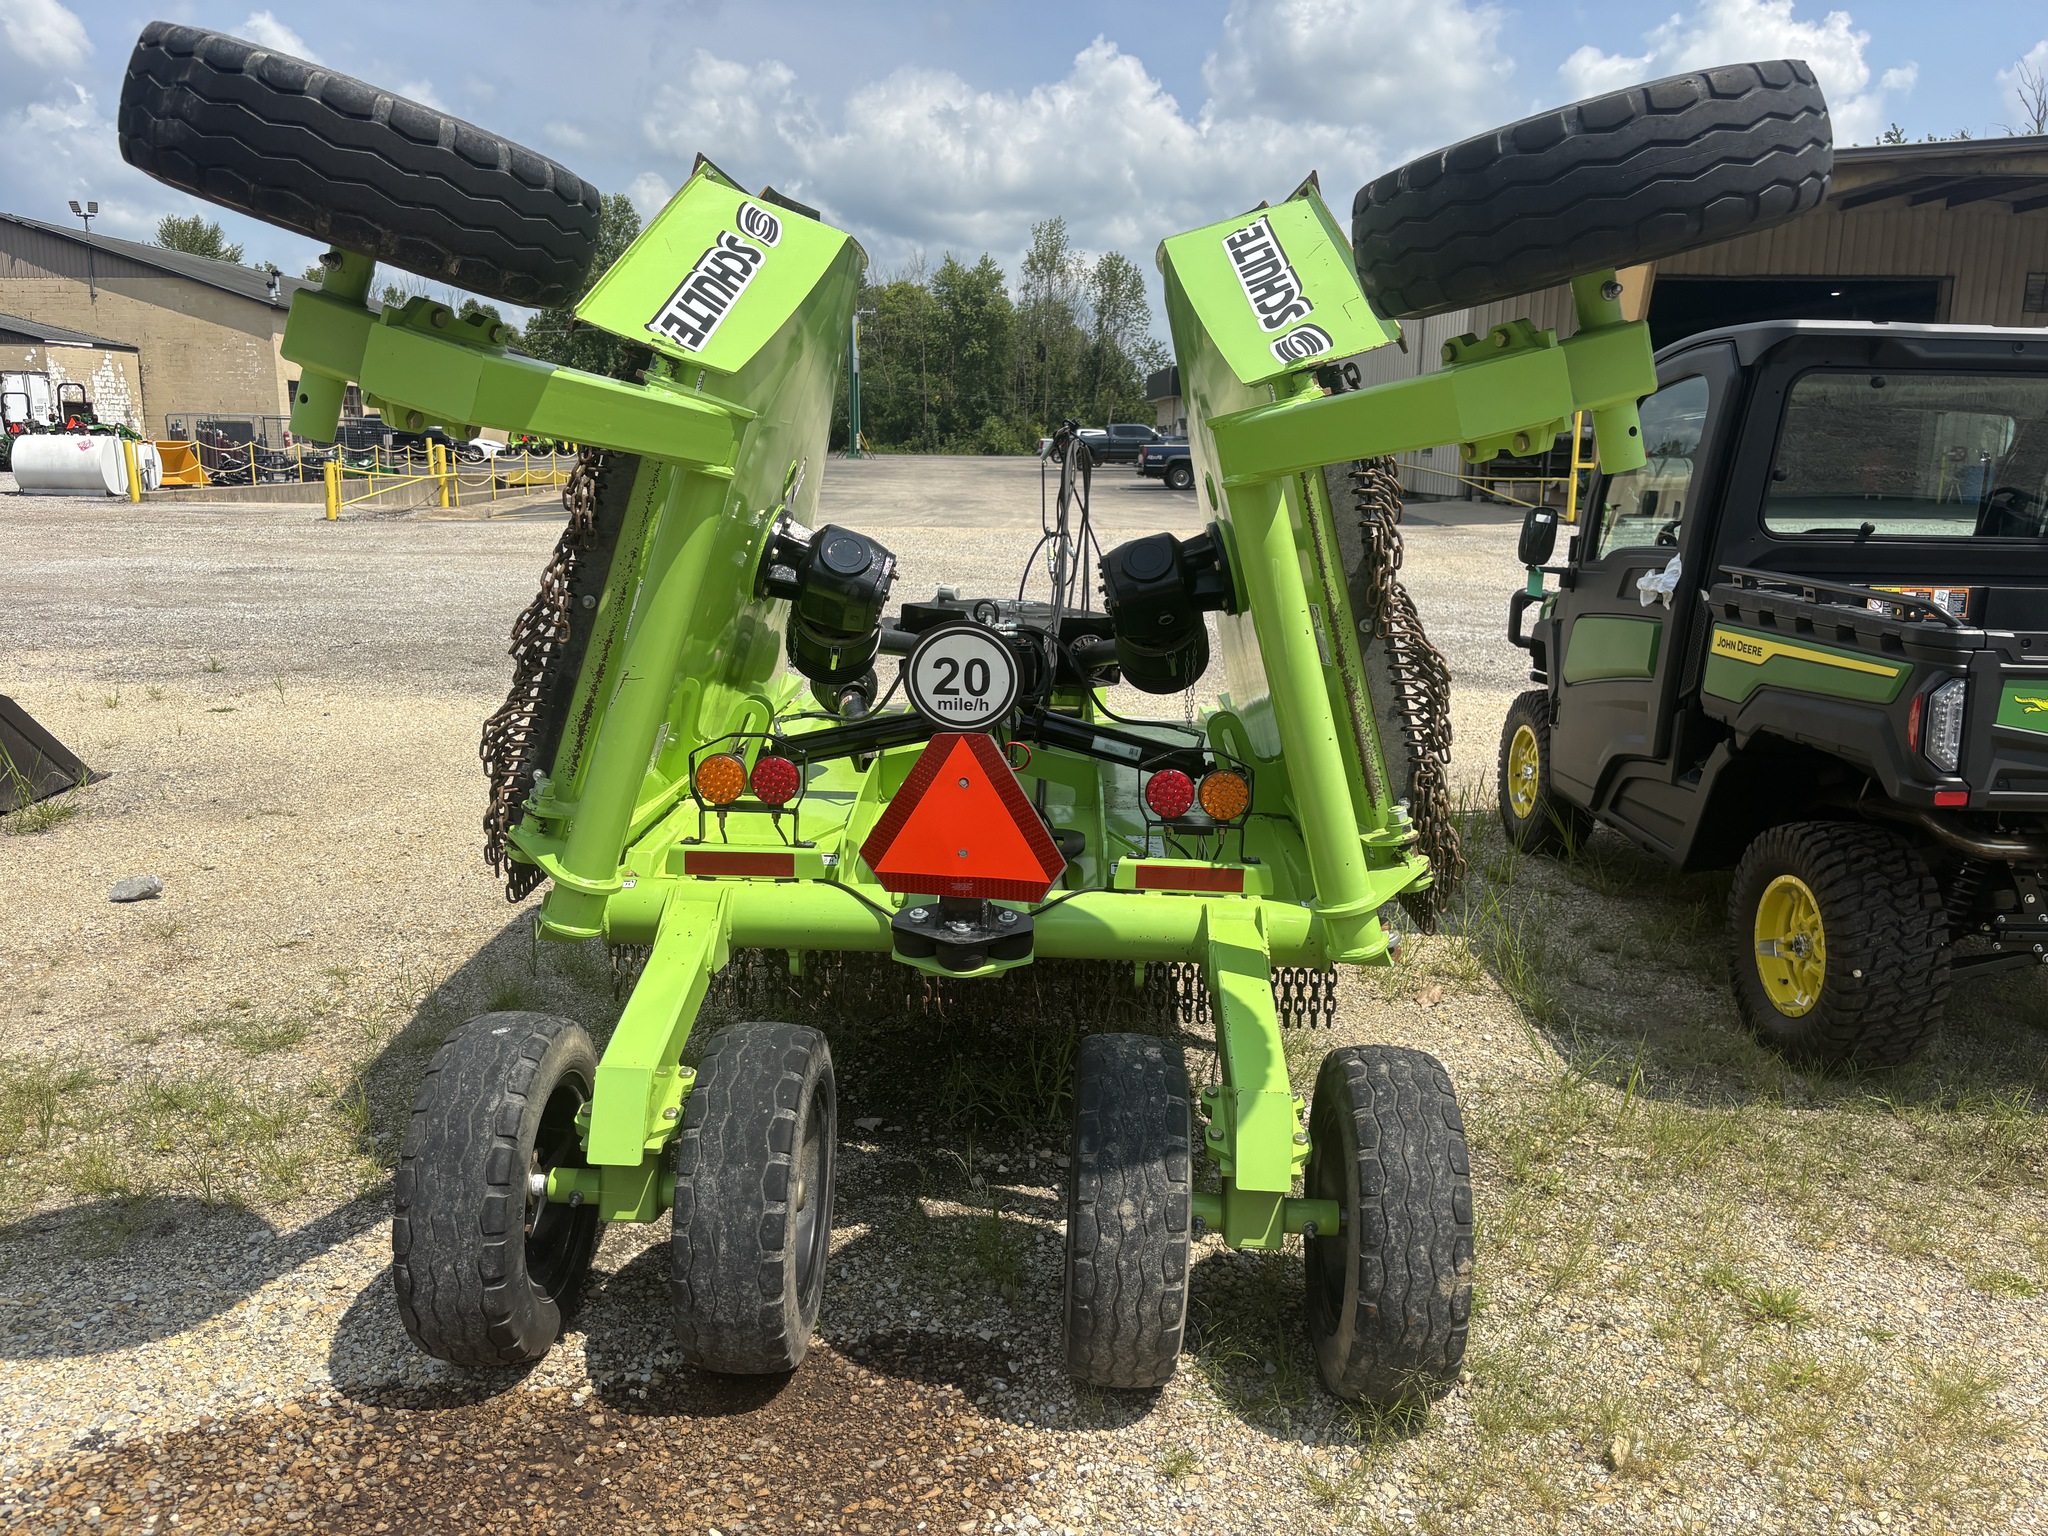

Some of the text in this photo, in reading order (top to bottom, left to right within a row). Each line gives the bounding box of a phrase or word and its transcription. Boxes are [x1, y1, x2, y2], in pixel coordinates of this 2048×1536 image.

[660, 234, 762, 348] SCHULTE
[1226, 225, 1306, 329] SCHULTE
[1716, 635, 1763, 657] JOHN DEERE
[932, 657, 991, 697] 20
[937, 697, 989, 712] mile/h
